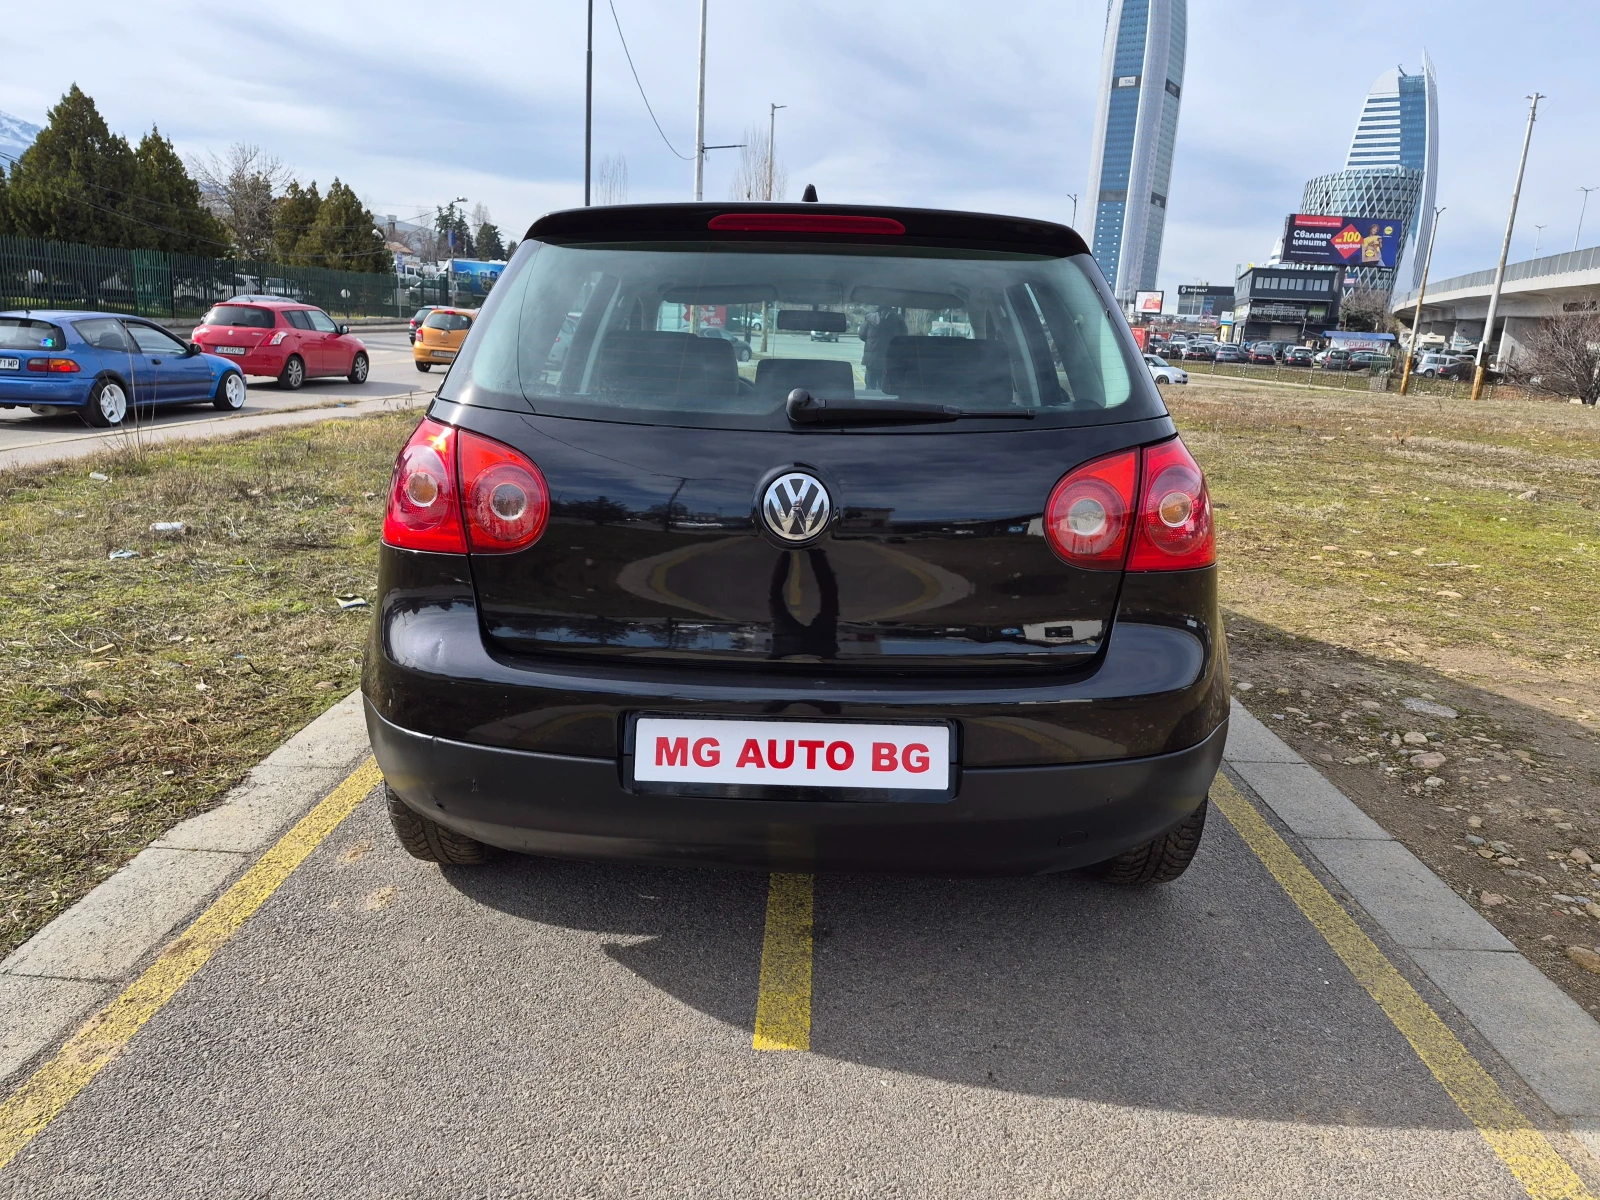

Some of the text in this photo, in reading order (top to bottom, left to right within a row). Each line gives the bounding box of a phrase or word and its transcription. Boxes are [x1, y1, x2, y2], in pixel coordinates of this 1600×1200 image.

[1294, 230, 1332, 239] Сваляме
[1343, 231, 1361, 243] 100
[1292, 239, 1327, 247] цените
[1344, 339, 1374, 349] Кредит
[655, 736, 930, 774] MG AUTO BG
